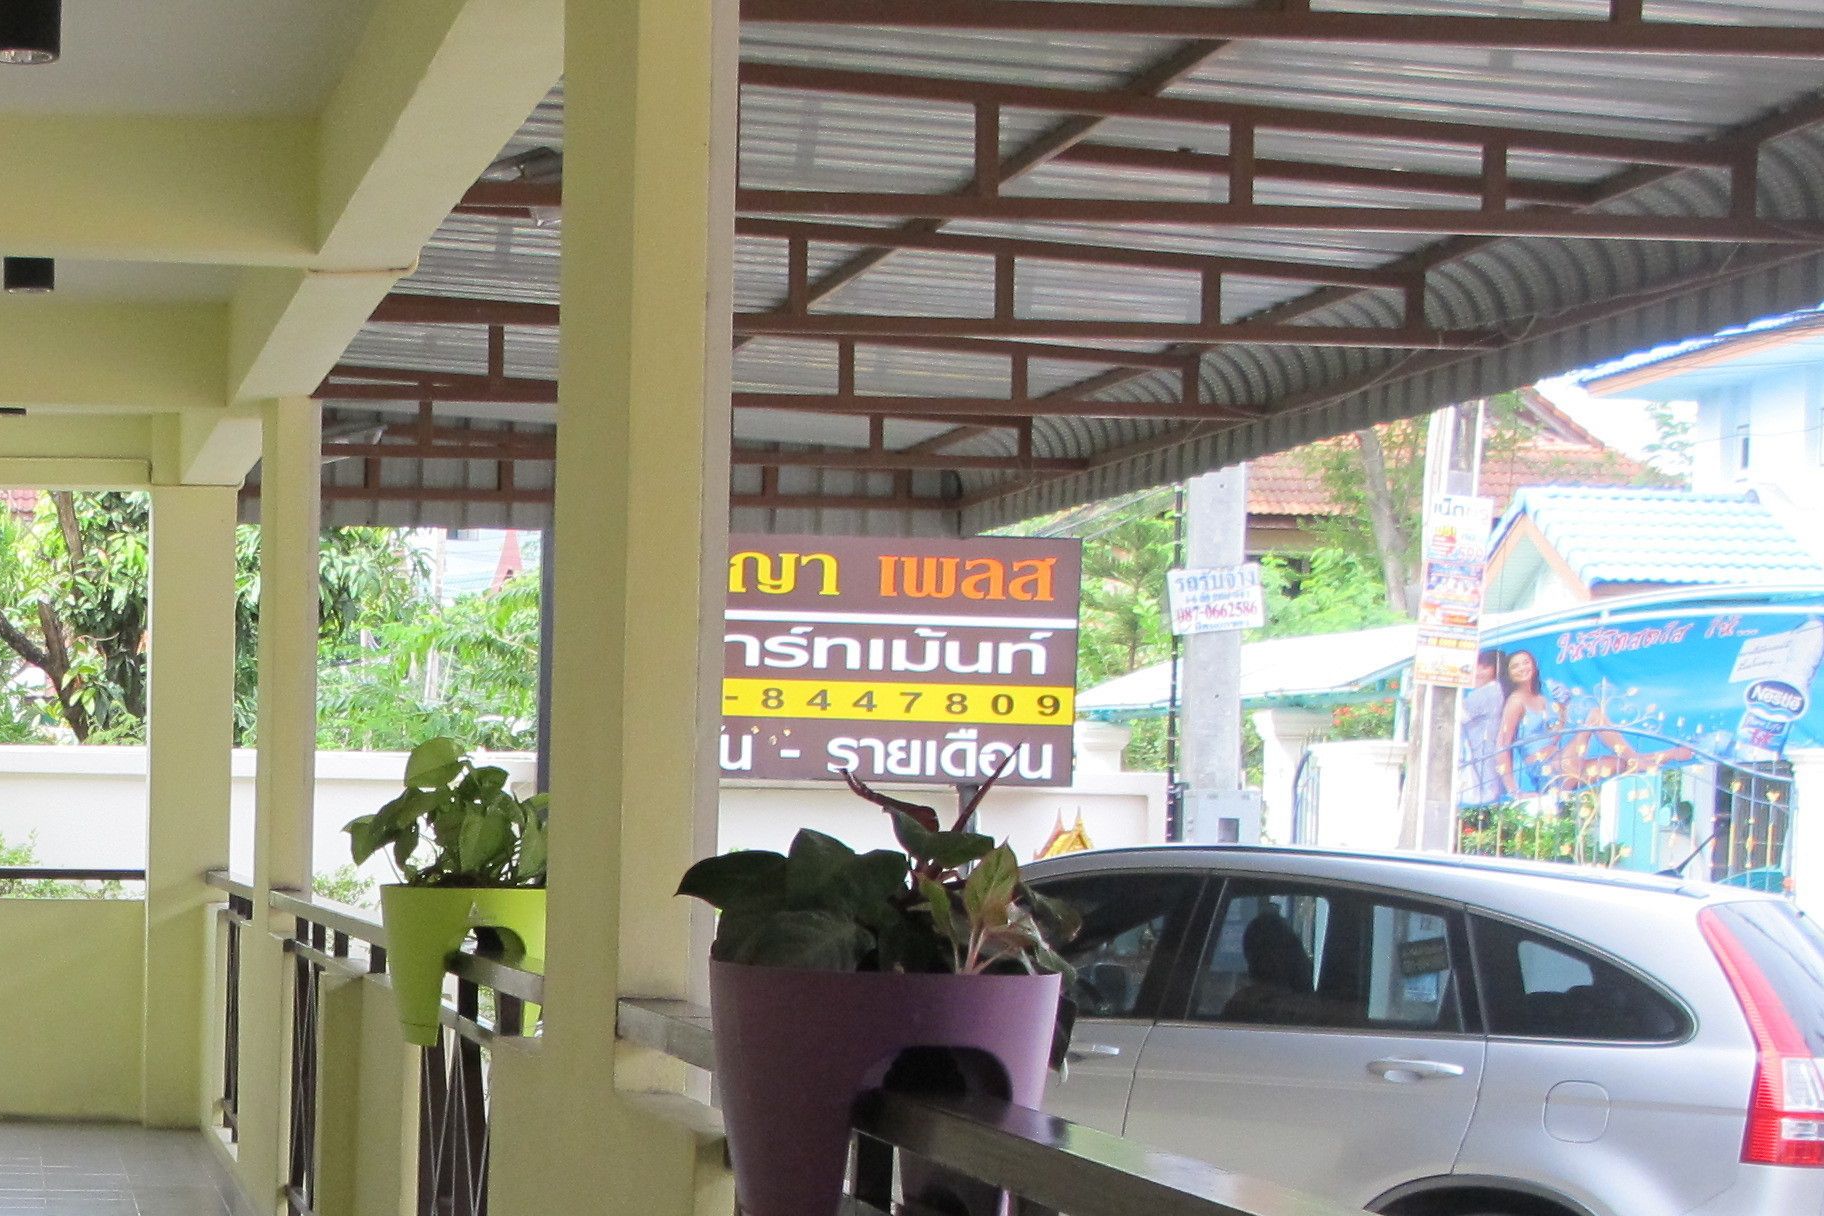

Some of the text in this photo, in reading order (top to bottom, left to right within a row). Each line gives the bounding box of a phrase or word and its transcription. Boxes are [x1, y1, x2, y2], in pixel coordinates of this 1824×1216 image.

[878, 554, 1057, 600] เพลส
[828, 729, 1054, 779] รายเดือน
